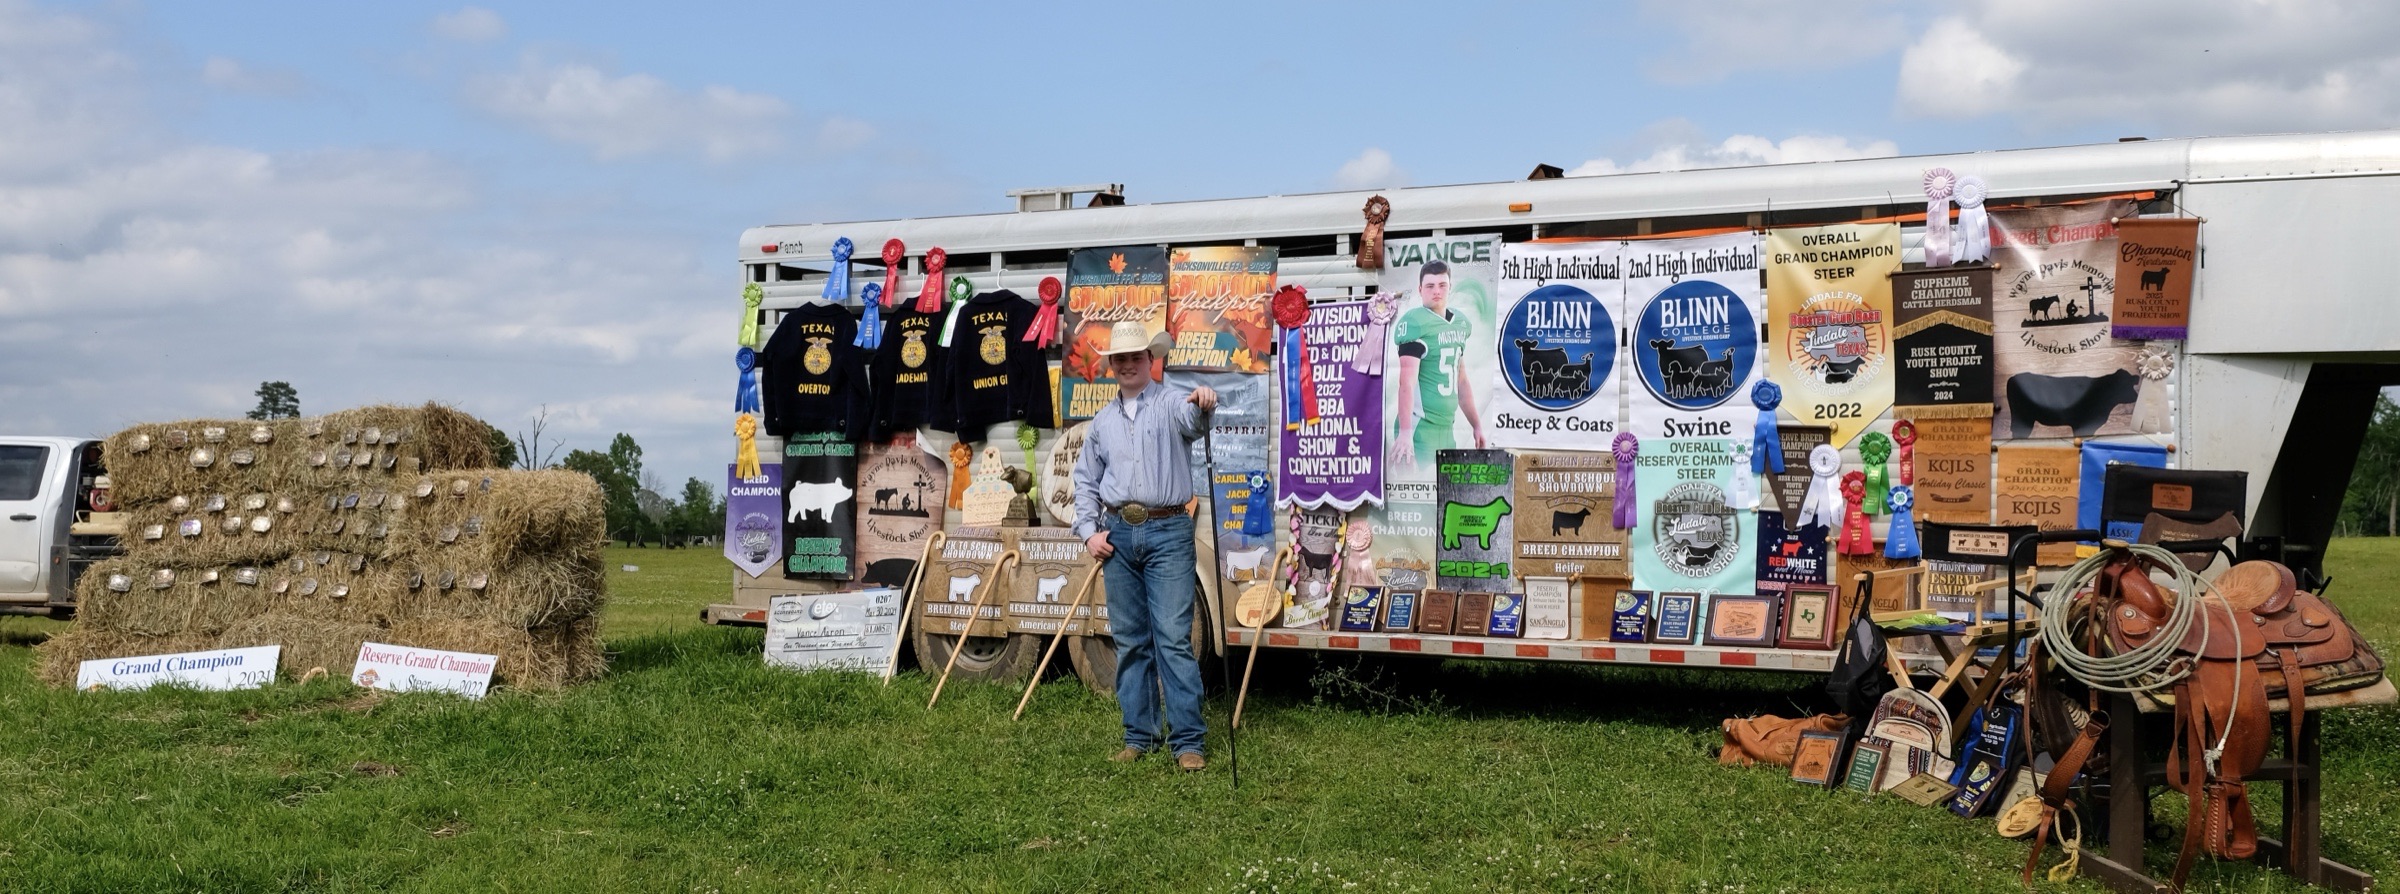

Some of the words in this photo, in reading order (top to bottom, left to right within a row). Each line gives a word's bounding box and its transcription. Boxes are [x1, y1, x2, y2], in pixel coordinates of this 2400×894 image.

[1802, 232, 1860, 246] OVERALL
[1388, 241, 1492, 267] VANCE
[1775, 252, 1818, 264] GRAND
[1822, 245, 1894, 263] CHAMPION
[2121, 242, 2192, 262] Champion
[1173, 262, 1227, 272] JACKSONVILLE
[1228, 262, 1243, 271] FFA
[1629, 253, 1651, 279] 2nd
[1655, 251, 1687, 283] High
[1692, 245, 1758, 274] Individual
[1502, 256, 1520, 280] 5th
[1524, 257, 1552, 287] High
[1556, 256, 1620, 280] Individual
[1814, 267, 1854, 280] STEER
[1914, 276, 1969, 289] SUPREME
[2008, 270, 2037, 299] Wayne
[2039, 258, 2068, 280] Davis
[1169, 274, 1270, 301] SHOOTOUT
[1911, 287, 1972, 300] CHAMPION
[1069, 285, 1164, 313] SHOOTOUT
[1801, 291, 1844, 310] LINDALE
[1846, 292, 1863, 304] FFA
[1903, 300, 1933, 309] CATTLE
[1935, 297, 1981, 307] HERDSMAN
[1172, 290, 1274, 324] Jackpot
[1661, 295, 1729, 328] BLINN
[1074, 301, 1166, 335] Jackpot
[1303, 306, 1363, 324] DIVISION
[1526, 301, 1592, 329] BLINN
[1790, 313, 1828, 329] BOOSTER
[1829, 311, 1854, 326] CLUB
[1854, 309, 1882, 324] BASH
[1398, 321, 1407, 337] 50
[1526, 329, 1592, 338] COLLEGE
[1662, 325, 1730, 336] COLLEGE
[1176, 332, 1216, 349] BREED
[1805, 327, 1849, 353] Lindale
[2020, 331, 2077, 354] Livestock
[2080, 326, 2108, 350] Show
[1321, 347, 1329, 360] &
[1835, 342, 1868, 357] TEXAS
[1911, 347, 1936, 357] RUSK
[1939, 345, 1977, 355] COUNTY
[1168, 350, 1228, 367] CHAMPION
[1905, 358, 1937, 368] YOUTH
[1940, 356, 1982, 367] PROJECT
[1313, 364, 1345, 381] BULL
[1788, 360, 1855, 397] LIVESTOCK
[1858, 352, 1887, 388] SHOW
[1930, 368, 1958, 378] SHOW
[974, 376, 998, 389] UNION
[1316, 384, 1341, 396] 2022
[1934, 391, 1953, 400] 2024
[1814, 403, 1862, 419] 2022
[1216, 426, 1266, 434] SPIRIT
[1296, 417, 1363, 436] NATIONAL
[1496, 414, 1541, 434] Sheep
[1546, 416, 1560, 430] &
[1566, 416, 1614, 432] Goats
[1664, 417, 1732, 438] Swine
[1800, 433, 1824, 442] BREED
[1298, 437, 1336, 456] SHOW
[1348, 437, 1360, 455] &
[1670, 442, 1724, 453] OVERALL
[1054, 451, 1068, 465] FFA
[1541, 457, 1579, 467] LUFKIN
[1581, 457, 1603, 466] FFA
[1637, 456, 1689, 466] RESERVE
[1288, 456, 1371, 476] CONVENTION
[1928, 459, 1975, 472] KCJLS
[744, 474, 769, 484] BREED
[861, 462, 884, 487] Wayne
[885, 455, 908, 468] Davis
[910, 457, 936, 493] Memorial
[1332, 476, 1354, 484] TEXAS
[1451, 474, 1509, 486] CLASSIC
[1527, 473, 1556, 483] BACK
[1559, 473, 1571, 483] TO
[1574, 472, 1616, 484] SCHOOL
[1677, 469, 1716, 479] STEER
[1539, 482, 1603, 493] SHOWDOWN
[1918, 478, 1952, 489] Holiday
[1955, 478, 1986, 488] Classic
[731, 487, 781, 496] CHAMPION
[1668, 483, 1705, 499] LINDALE
[1707, 485, 1723, 498] FFA
[2012, 501, 2061, 516] KCJLS
[1388, 512, 1422, 522] BREED
[866, 518, 906, 542] Livestock
[909, 522, 929, 541] Show
[1372, 525, 1436, 537] CHAMPION
[1669, 515, 1709, 536] Lindale
[2040, 520, 2073, 531] Classic
[1696, 531, 1724, 542] TEXAS
[959, 541, 968, 550] TO
[970, 541, 1003, 552] SCHOOL
[1054, 543, 1088, 553] SCHOOL
[1523, 544, 1557, 556] BREED
[1561, 544, 1620, 557] CHAMPION
[943, 551, 992, 560] SHOWDOWN
[1029, 551, 1078, 560] SHOWDOWN
[1655, 543, 1711, 578] LIVESTOCK
[1713, 541, 1740, 574] SHOW
[1439, 560, 1510, 579] 2024
[1555, 562, 1585, 573] Heifer
[1851, 558, 1894, 569] CHAMPION
[1938, 564, 1966, 572] PROJECT
[1967, 564, 1986, 572] SHOW
[876, 595, 892, 604] 0207
[928, 605, 952, 614] BREED
[1009, 604, 1046, 614] RESERVE
[1019, 620, 1055, 631] American
[1544, 618, 1566, 628] ANGELO
[112, 659, 161, 676] Grand
[167, 653, 243, 672] Champion
[361, 646, 402, 665] Reserve
[405, 652, 439, 669] Grand
[440, 655, 490, 677] Champion
[406, 674, 432, 691] Steer
